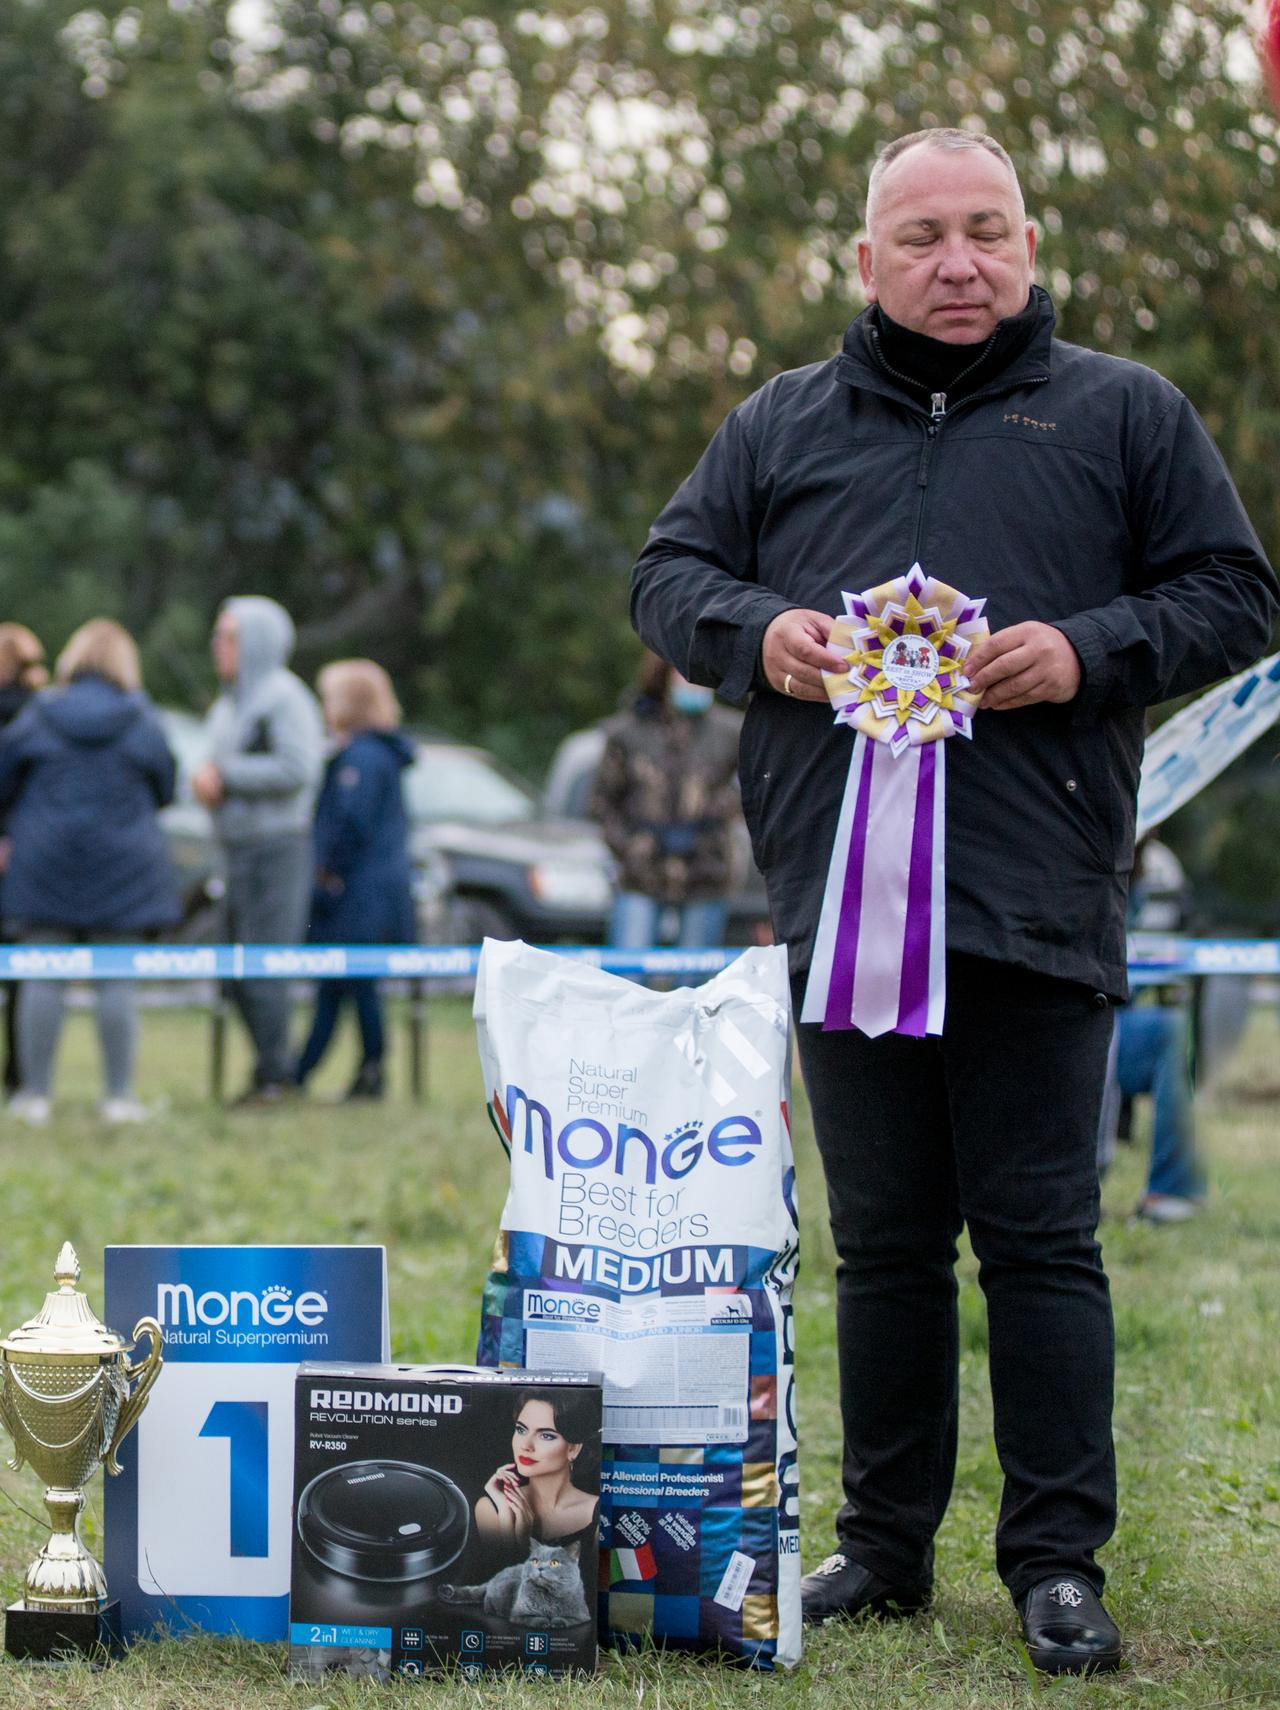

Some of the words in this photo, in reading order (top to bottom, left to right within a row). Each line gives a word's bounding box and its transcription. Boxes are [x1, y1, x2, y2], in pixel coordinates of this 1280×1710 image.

[569, 1058, 638, 1084] Natural
[568, 1076, 628, 1100] Super
[567, 1095, 648, 1126] Premium
[560, 1172, 638, 1217] Best
[646, 1186, 686, 1219] for
[558, 1204, 710, 1250] Breeders
[554, 1245, 735, 1292] MEDIUM
[215, 1329, 328, 1348] Superpremium
[310, 1412, 393, 1425] REVOLUTION
[396, 1416, 438, 1427] series
[310, 1440, 347, 1451] RV-R350
[198, 1401, 269, 1558] 1
[601, 1484, 664, 1496] Professional
[665, 1486, 710, 1497] Breeders
[612, 1471, 659, 1482] Allevatori
[660, 1473, 724, 1484] Professionisti
[619, 1514, 647, 1545] Italian
[630, 1511, 652, 1535] 100%
[671, 1520, 696, 1546] vendita
